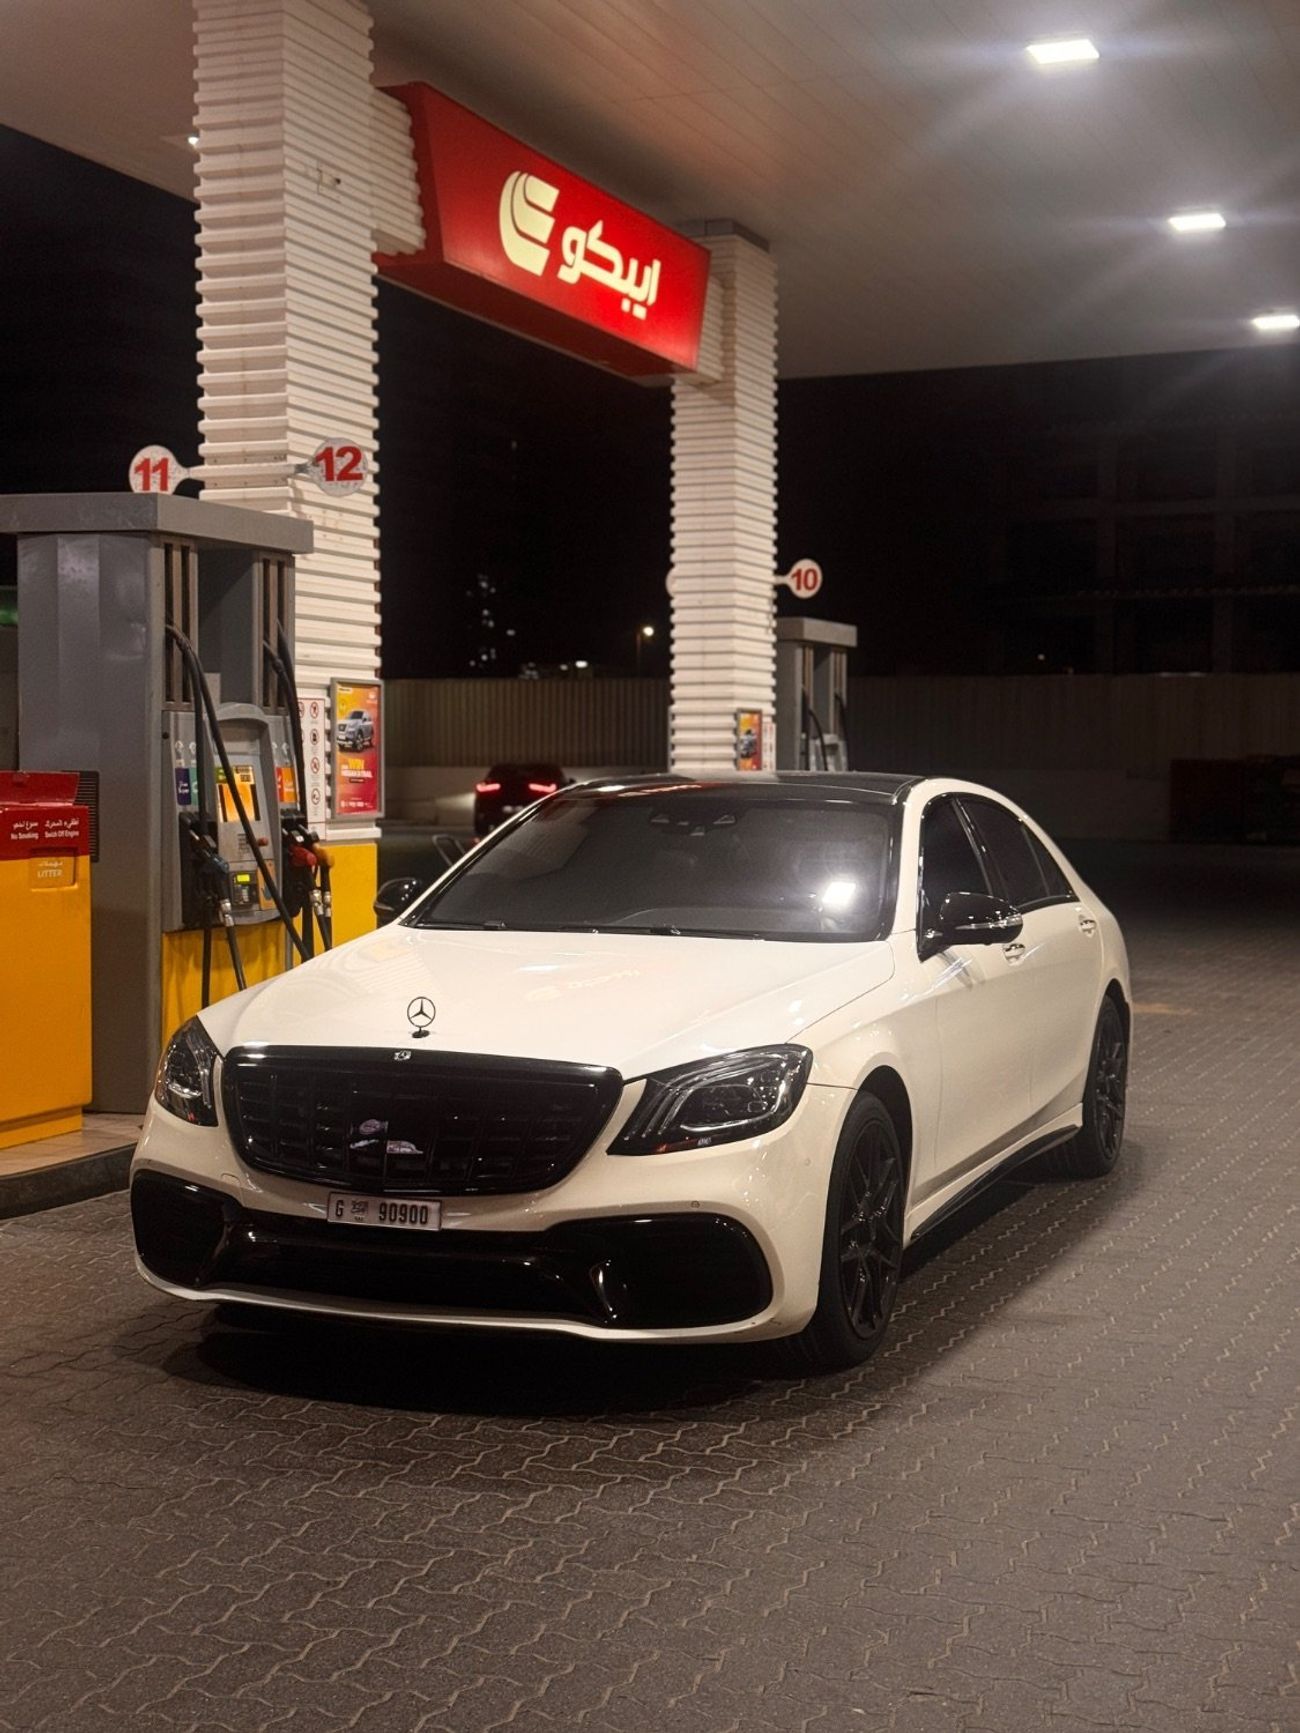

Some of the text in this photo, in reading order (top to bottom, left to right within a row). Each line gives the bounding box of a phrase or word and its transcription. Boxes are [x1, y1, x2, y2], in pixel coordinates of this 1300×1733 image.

[134, 457, 169, 492] 11
[314, 445, 363, 482] 12
[791, 567, 818, 591] 10
[335, 1200, 344, 1217] G
[379, 1203, 428, 1225] 90900
